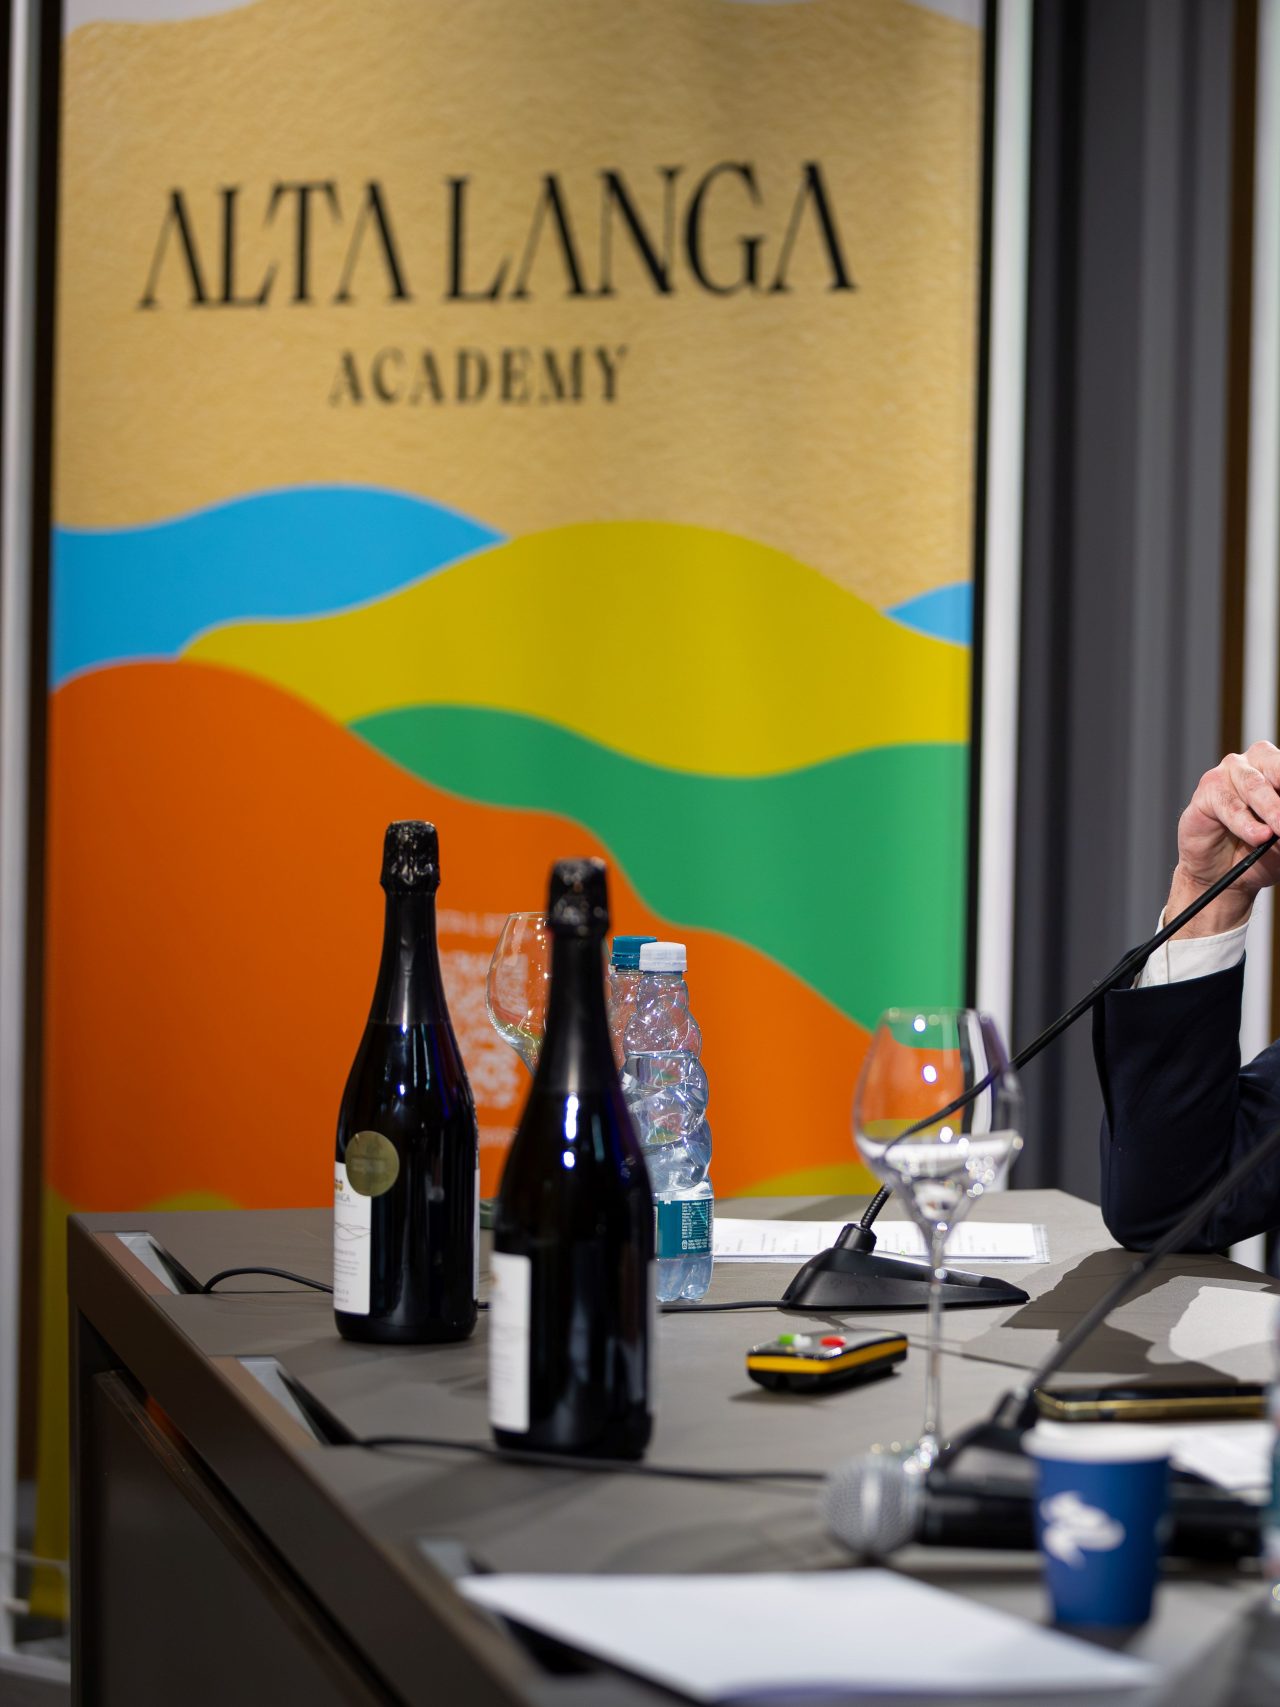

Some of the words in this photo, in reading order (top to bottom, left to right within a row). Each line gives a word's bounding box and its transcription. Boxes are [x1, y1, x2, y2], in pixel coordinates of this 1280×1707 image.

[136, 178, 413, 311] ALTA
[443, 160, 859, 304] LANGA
[329, 344, 629, 407] ACADEMY
